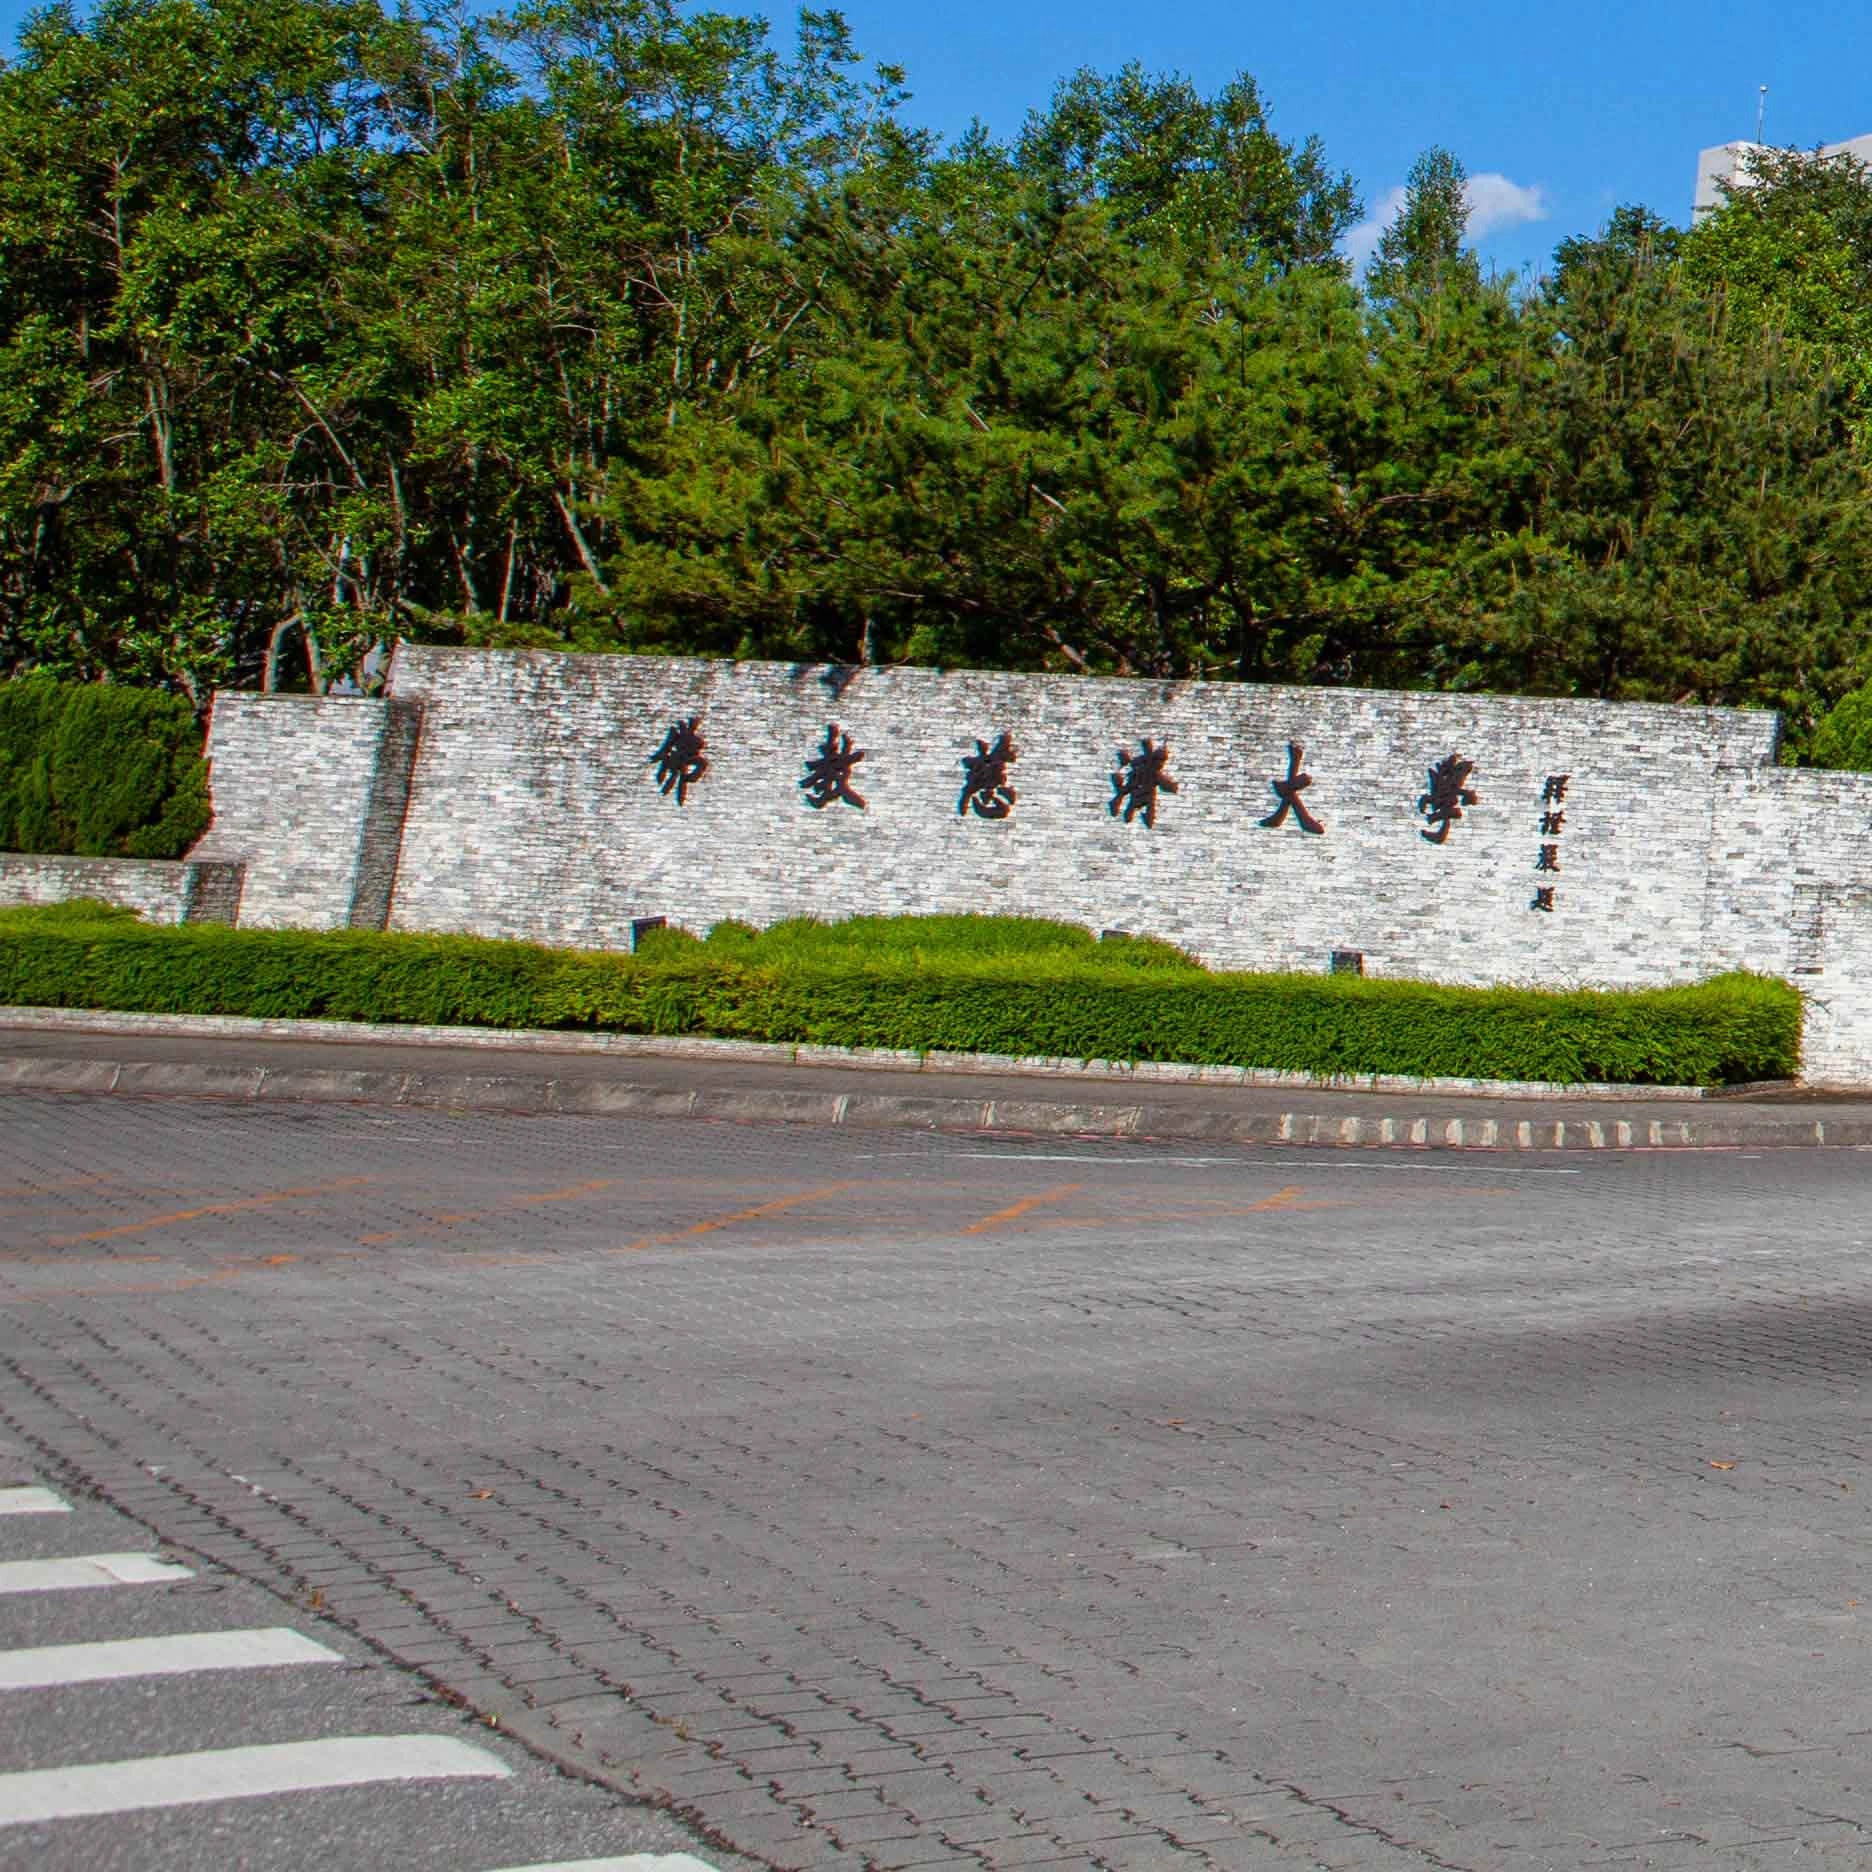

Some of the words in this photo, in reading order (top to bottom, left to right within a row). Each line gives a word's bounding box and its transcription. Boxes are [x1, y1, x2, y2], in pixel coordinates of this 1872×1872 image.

[649, 715, 1479, 845] 佛教慈濟大學
